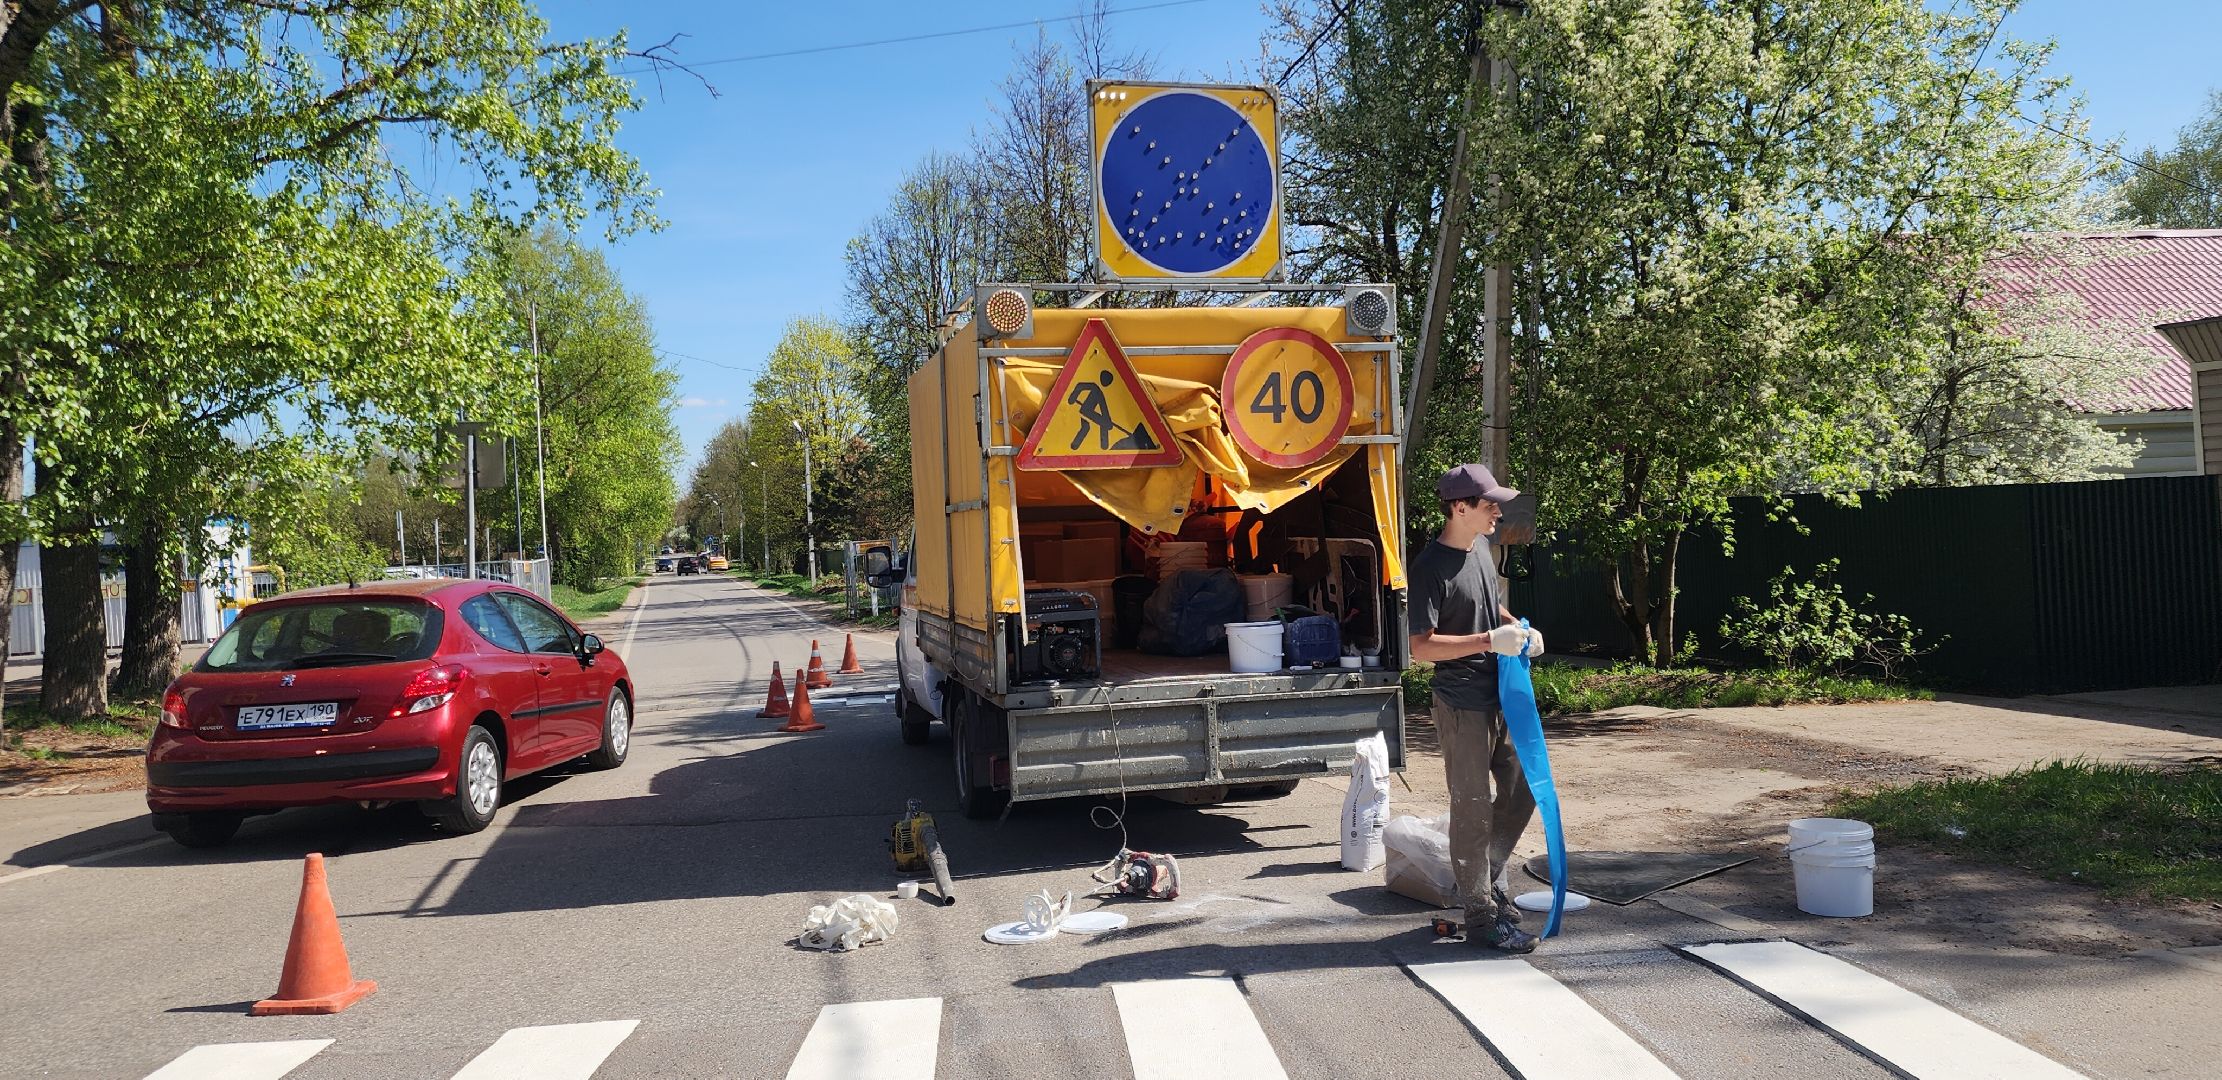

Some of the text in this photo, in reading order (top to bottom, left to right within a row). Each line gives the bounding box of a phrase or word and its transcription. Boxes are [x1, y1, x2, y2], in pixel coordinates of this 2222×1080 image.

[1250, 370, 1324, 424] 40
[243, 703, 334, 725] Е791ЕХ 190
